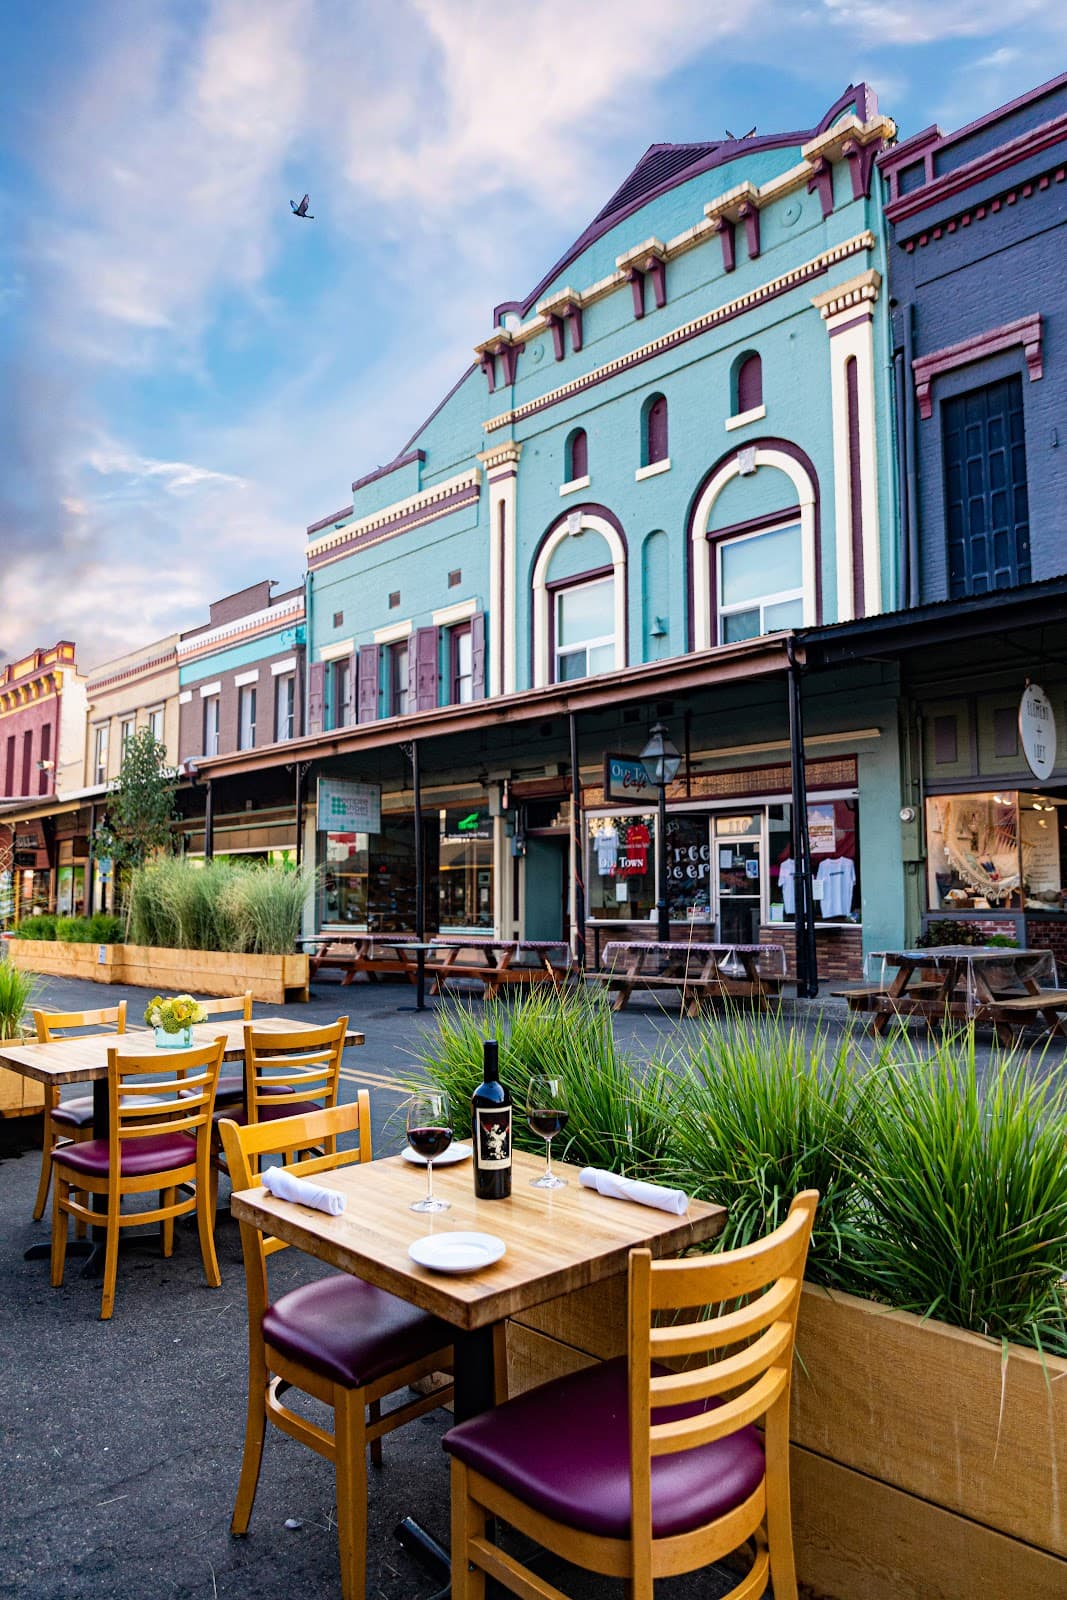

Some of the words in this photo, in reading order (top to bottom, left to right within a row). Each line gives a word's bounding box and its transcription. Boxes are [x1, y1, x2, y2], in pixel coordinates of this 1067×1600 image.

[1027, 701, 1049, 721] ELEMENT
[1033, 743, 1046, 761] LOFT
[618, 856, 644, 869] TOWN
